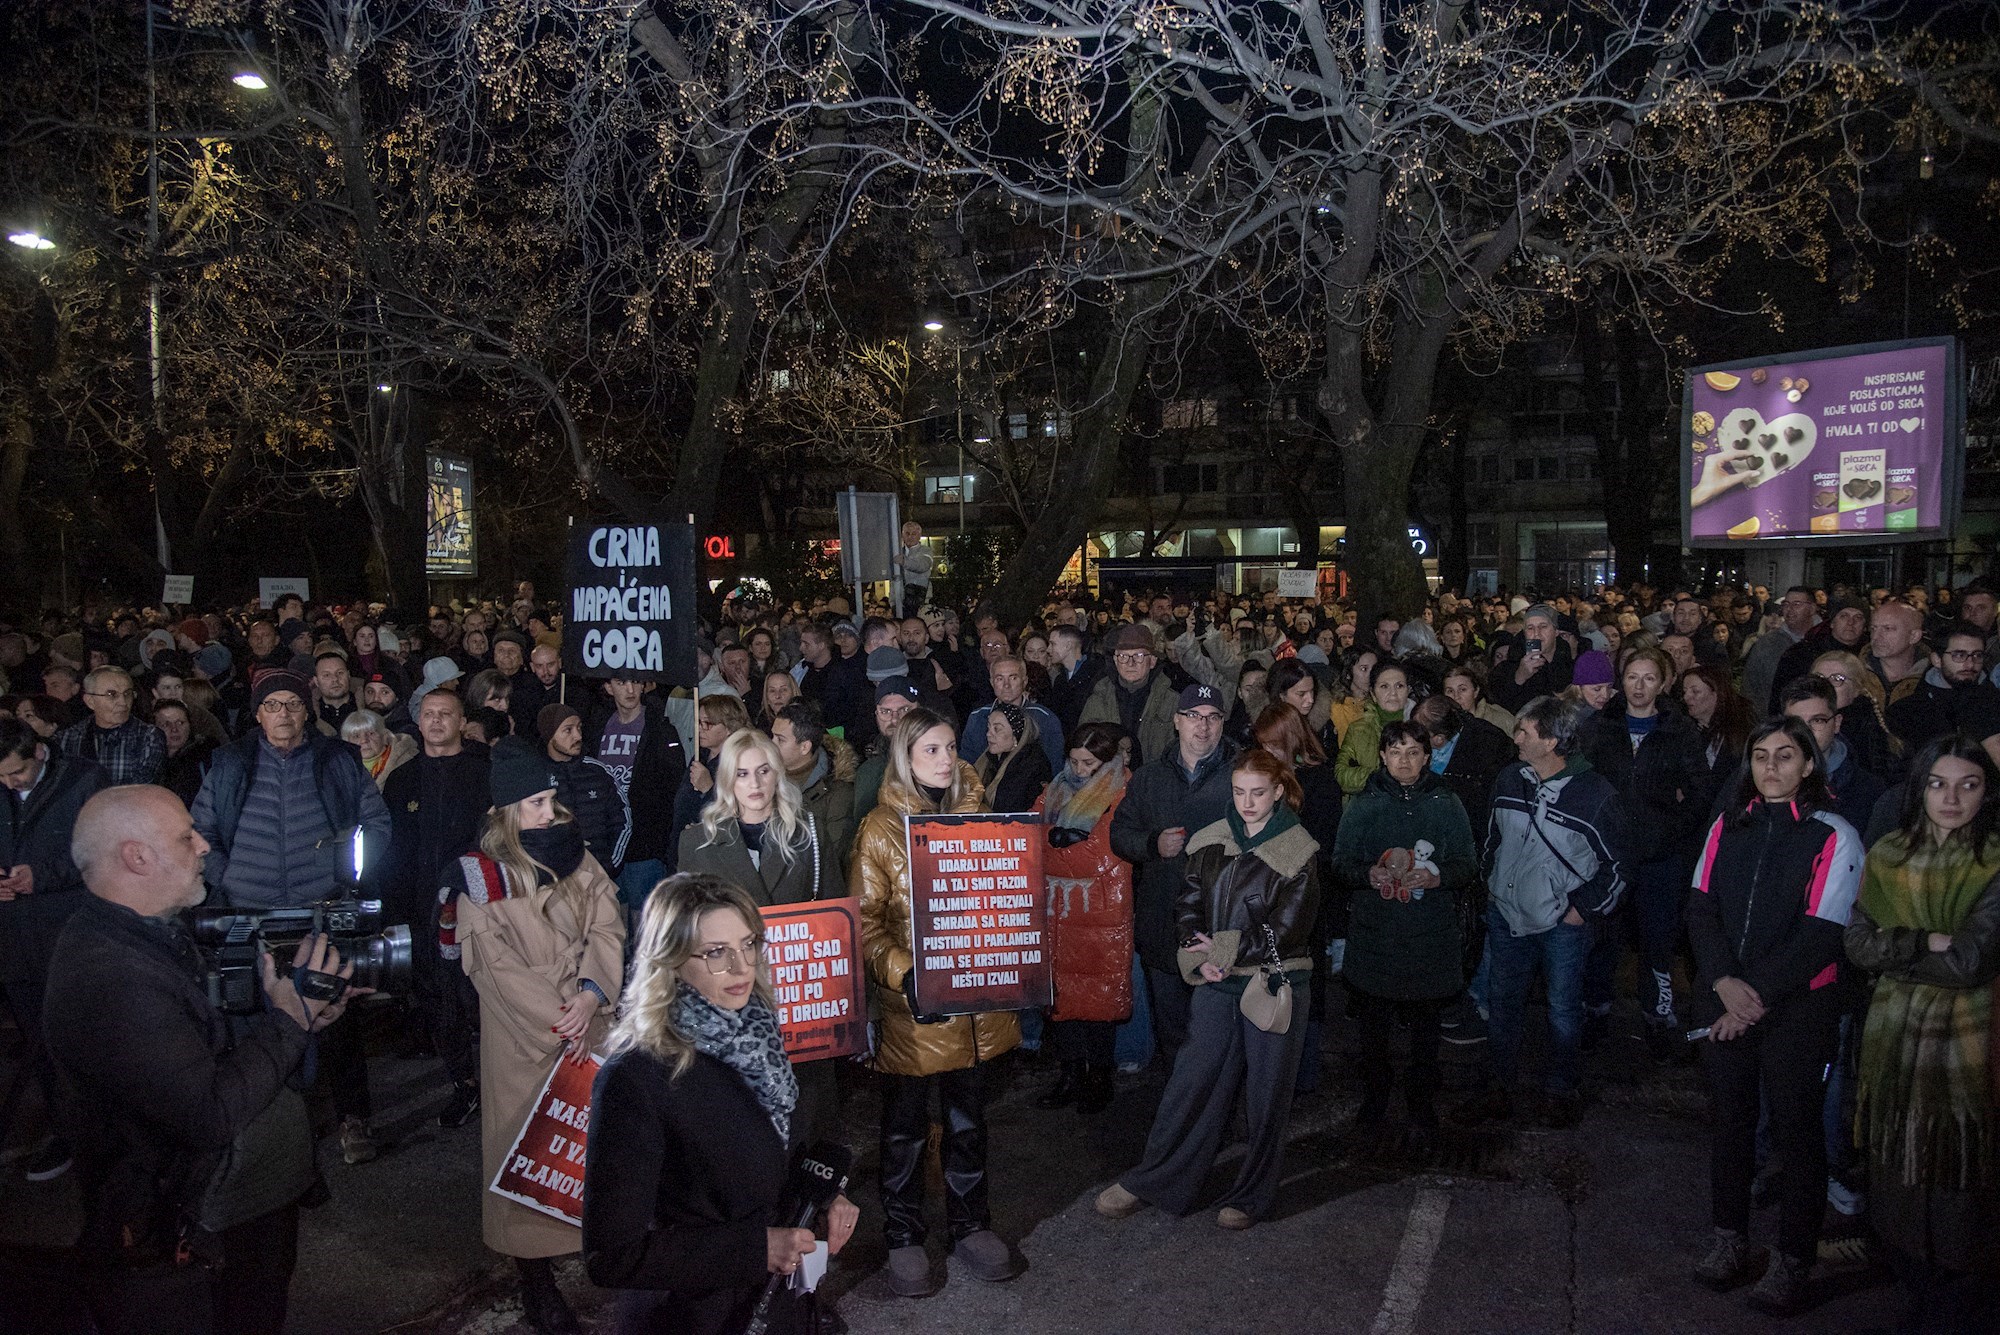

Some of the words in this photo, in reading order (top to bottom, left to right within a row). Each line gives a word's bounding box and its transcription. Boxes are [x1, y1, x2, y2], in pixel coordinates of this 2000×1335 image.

[1864, 370, 1926, 386] INSPIRISANE
[1849, 384, 1925, 401] POSLASTICAMA
[1824, 405, 1846, 416] KOJE
[1850, 400, 1877, 414] VOLIŠ
[1881, 400, 1894, 411] OD
[1898, 398, 1924, 409] SRCA
[1826, 424, 1863, 438] HVALA
[1867, 422, 1878, 434] TI
[1882, 421, 1898, 433] OD
[1844, 454, 1880, 465] plazma
[589, 526, 661, 567] CRNA
[620, 569, 625, 588] i
[573, 577, 671, 622] NAPAĆENA
[583, 626, 664, 672] GORA
[1198, 686, 1211, 698] NY
[970, 839, 1005, 853] BRALE,
[1008, 839, 1012, 851] I
[1014, 838, 1026, 851] NE
[938, 859, 978, 872] UDARAJ
[981, 857, 1019, 871] LAMENT
[933, 879, 948, 892] NA
[951, 878, 968, 891] TAJ
[971, 877, 994, 891] SMO
[997, 876, 1027, 889] FAZON
[929, 898, 980, 912] MAJMUNE
[984, 897, 988, 910] I
[990, 894, 1033, 910] PRIZVALI
[933, 916, 978, 930] SMRADA
[981, 915, 995, 928] SA
[998, 913, 1030, 927] FARME
[923, 935, 970, 950] PUSTIMO
[974, 935, 981, 948] U
[984, 931, 1041, 947] PARLAMENT
[784, 943, 809, 962] ONI
[813, 939, 841, 959] SAD
[925, 956, 954, 970] ONDA
[958, 955, 971, 968] SE
[974, 952, 1019, 967] KRSTIMO
[1022, 950, 1041, 964] KAD
[776, 964, 804, 984] PUT
[808, 961, 827, 980] DA
[831, 958, 849, 976] MI
[952, 971, 984, 988] NEŠTO
[987, 971, 1019, 985] IZVALI
[804, 982, 823, 1001] PO
[793, 998, 849, 1023] DRUGA?
[546, 1097, 591, 1133] NAŠ
[549, 1134, 567, 1155] U
[801, 1158, 834, 1180] RTCG
